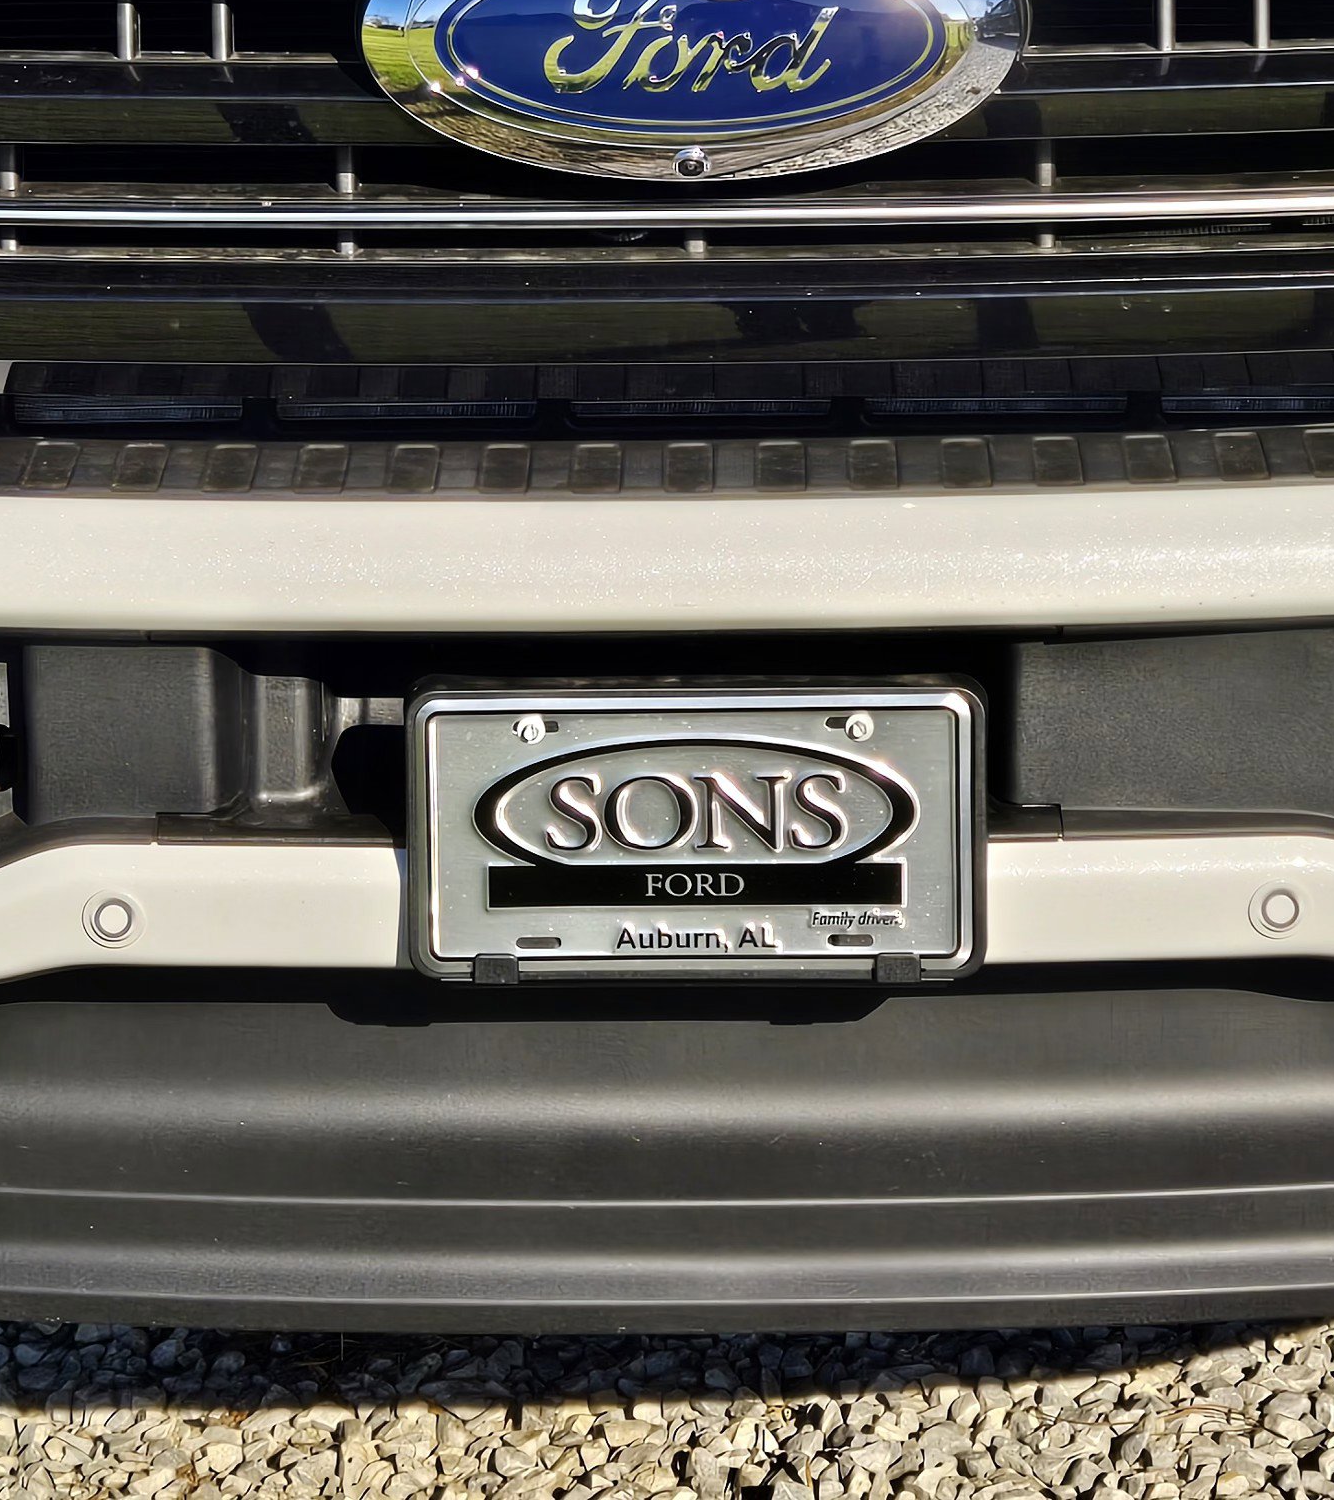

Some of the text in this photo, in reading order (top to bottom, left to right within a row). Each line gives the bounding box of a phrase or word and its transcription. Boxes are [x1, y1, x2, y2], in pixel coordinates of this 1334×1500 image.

[545, 773, 849, 852] SONS
[645, 873, 745, 897] FORD
[812, 911, 856, 930] Family
[616, 927, 779, 953] Auburn, AL
